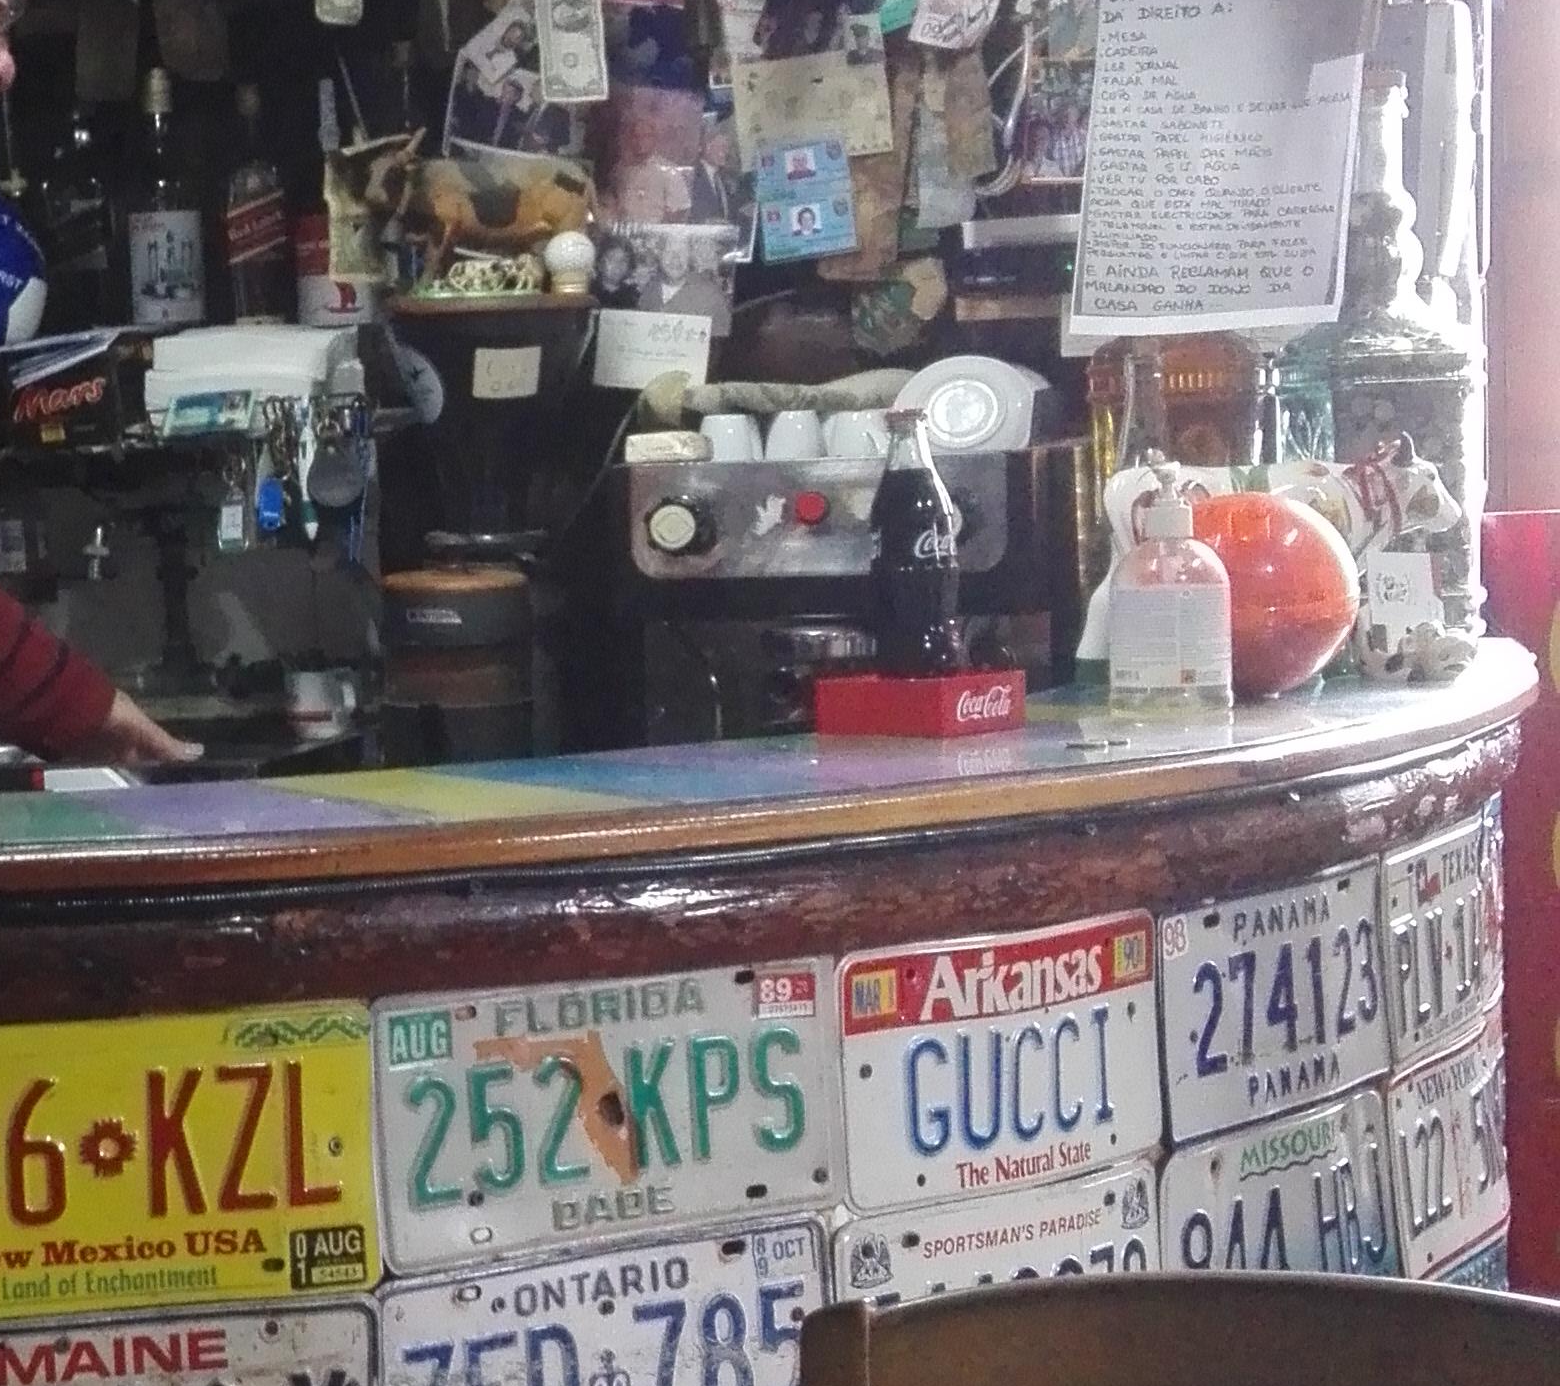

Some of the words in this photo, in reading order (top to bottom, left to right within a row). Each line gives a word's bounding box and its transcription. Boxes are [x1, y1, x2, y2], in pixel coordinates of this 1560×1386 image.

[1094, 298, 1138, 312] CASA
[12, 375, 108, 423] Mars
[1164, 917, 1187, 957] 98
[1232, 892, 1332, 945] PANAMA
[493, 978, 707, 1037] FLORIDA
[759, 976, 794, 1003] 89
[919, 944, 1103, 1021] Arkansas
[1192, 917, 1378, 1079] 274123
[391, 1018, 449, 1062] AUG
[903, 1002, 1116, 1157] GUCCI
[1248, 1052, 1342, 1105] PANAMA
[145, 1060, 344, 1217] KZL
[406, 1057, 591, 1209] 252
[625, 1024, 806, 1170] KPS
[955, 1160, 989, 1189] The
[994, 1146, 1055, 1184] Natural
[1058, 1140, 1092, 1169] State
[40, 1236, 181, 1267] Mexico
[185, 1229, 267, 1257] USA
[314, 1230, 362, 1257] AUG
[772, 1238, 806, 1262] OCT
[922, 1224, 1035, 1260] SPORTSMAN'S
[1039, 1207, 1104, 1239] PARADISE
[1, 1274, 52, 1303] Land
[56, 1272, 79, 1297] of
[83, 1266, 218, 1296] Enchantment
[513, 1256, 690, 1317] ONTARIO
